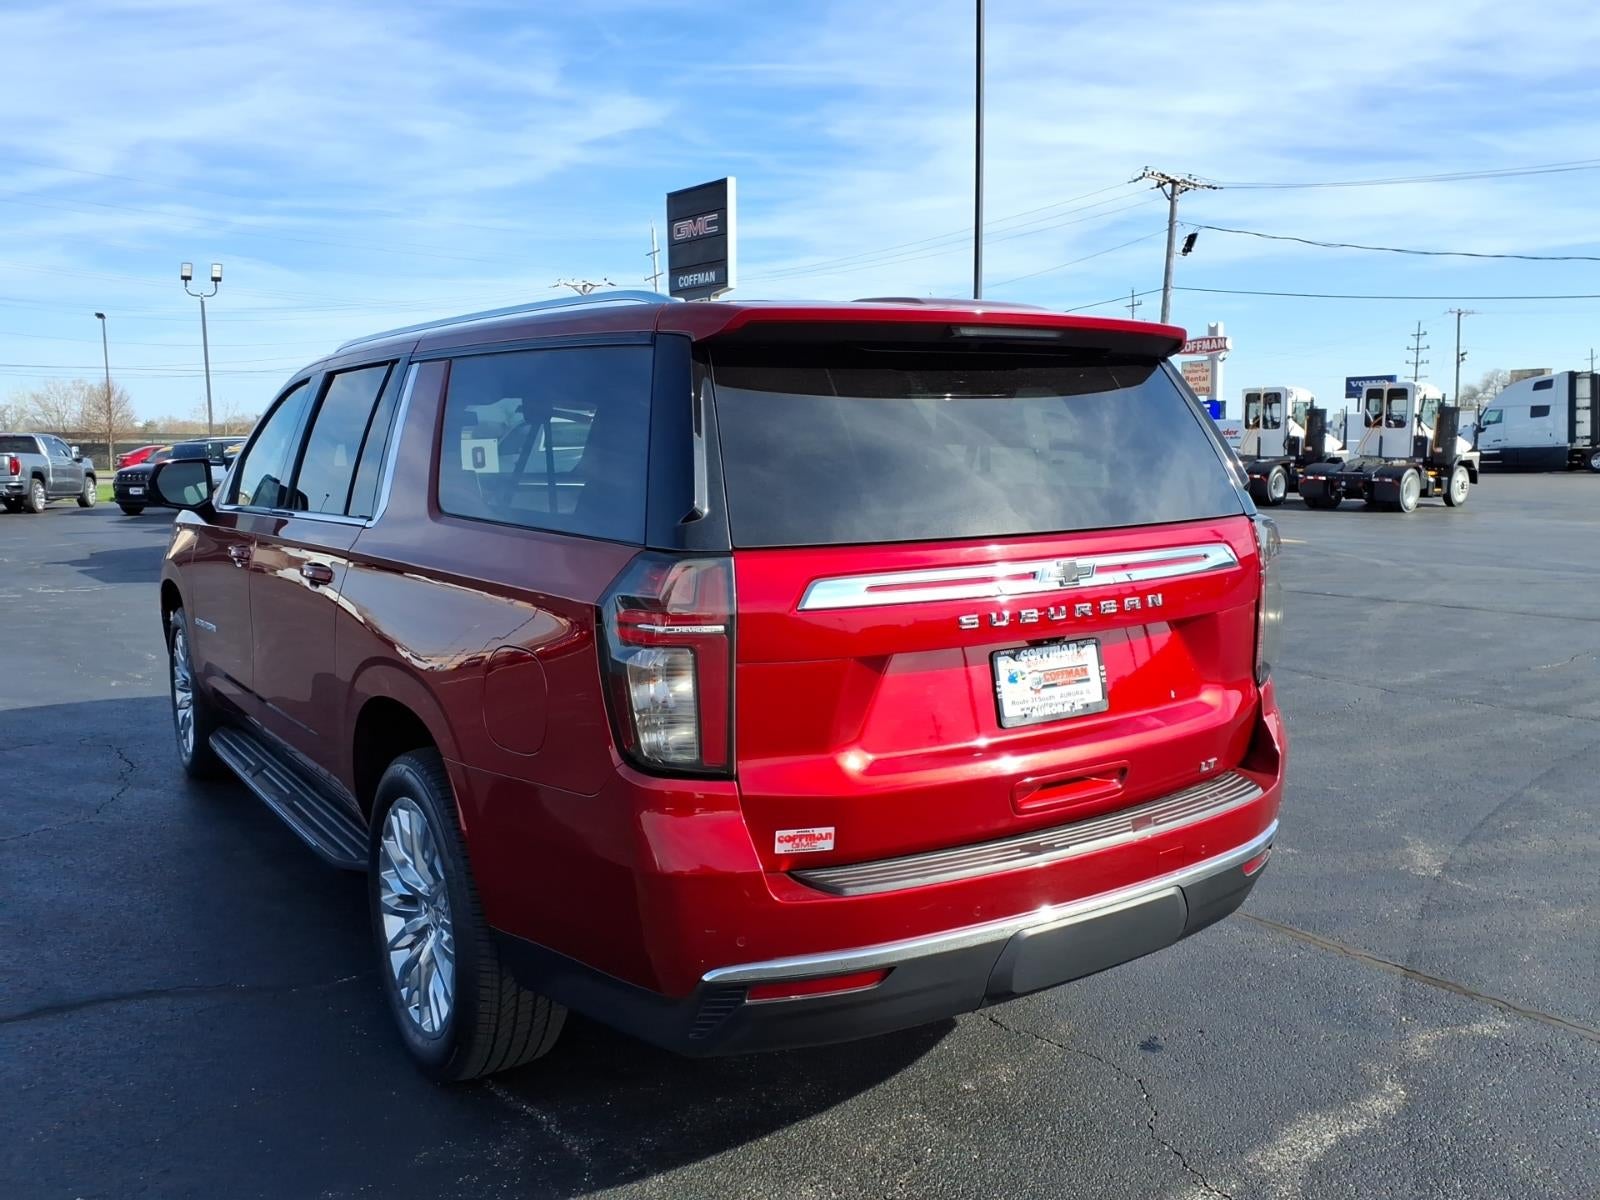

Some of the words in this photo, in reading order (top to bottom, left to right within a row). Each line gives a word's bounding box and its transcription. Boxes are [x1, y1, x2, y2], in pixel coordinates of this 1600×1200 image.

[673, 213, 718, 240] GMC
[678, 270, 716, 287] COFFMAN
[1181, 338, 1225, 352] OFFMAN
[1185, 375, 1208, 383] Rental
[1350, 379, 1388, 388] VOO
[958, 593, 1164, 630] SUBURBAN
[1200, 757, 1217, 771] LT
